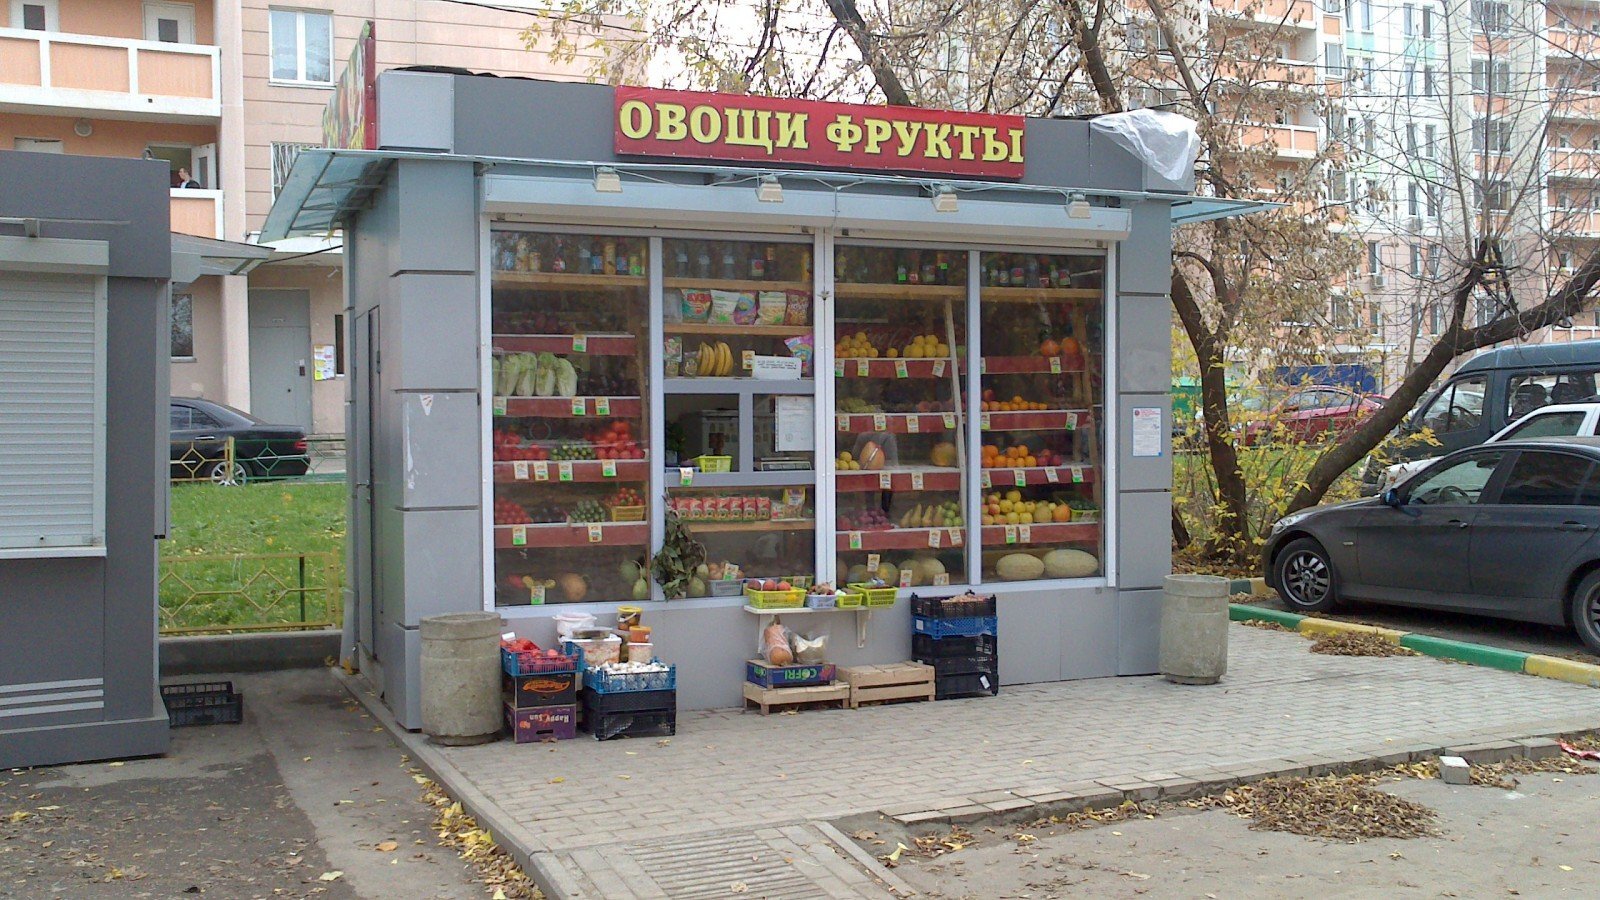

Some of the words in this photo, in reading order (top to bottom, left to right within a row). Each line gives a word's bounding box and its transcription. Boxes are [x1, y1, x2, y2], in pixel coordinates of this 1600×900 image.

[618, 99, 809, 155] ОВОЩИ
[826, 114, 1025, 163] ФРУКТЫ
[784, 667, 818, 681] COFRI
